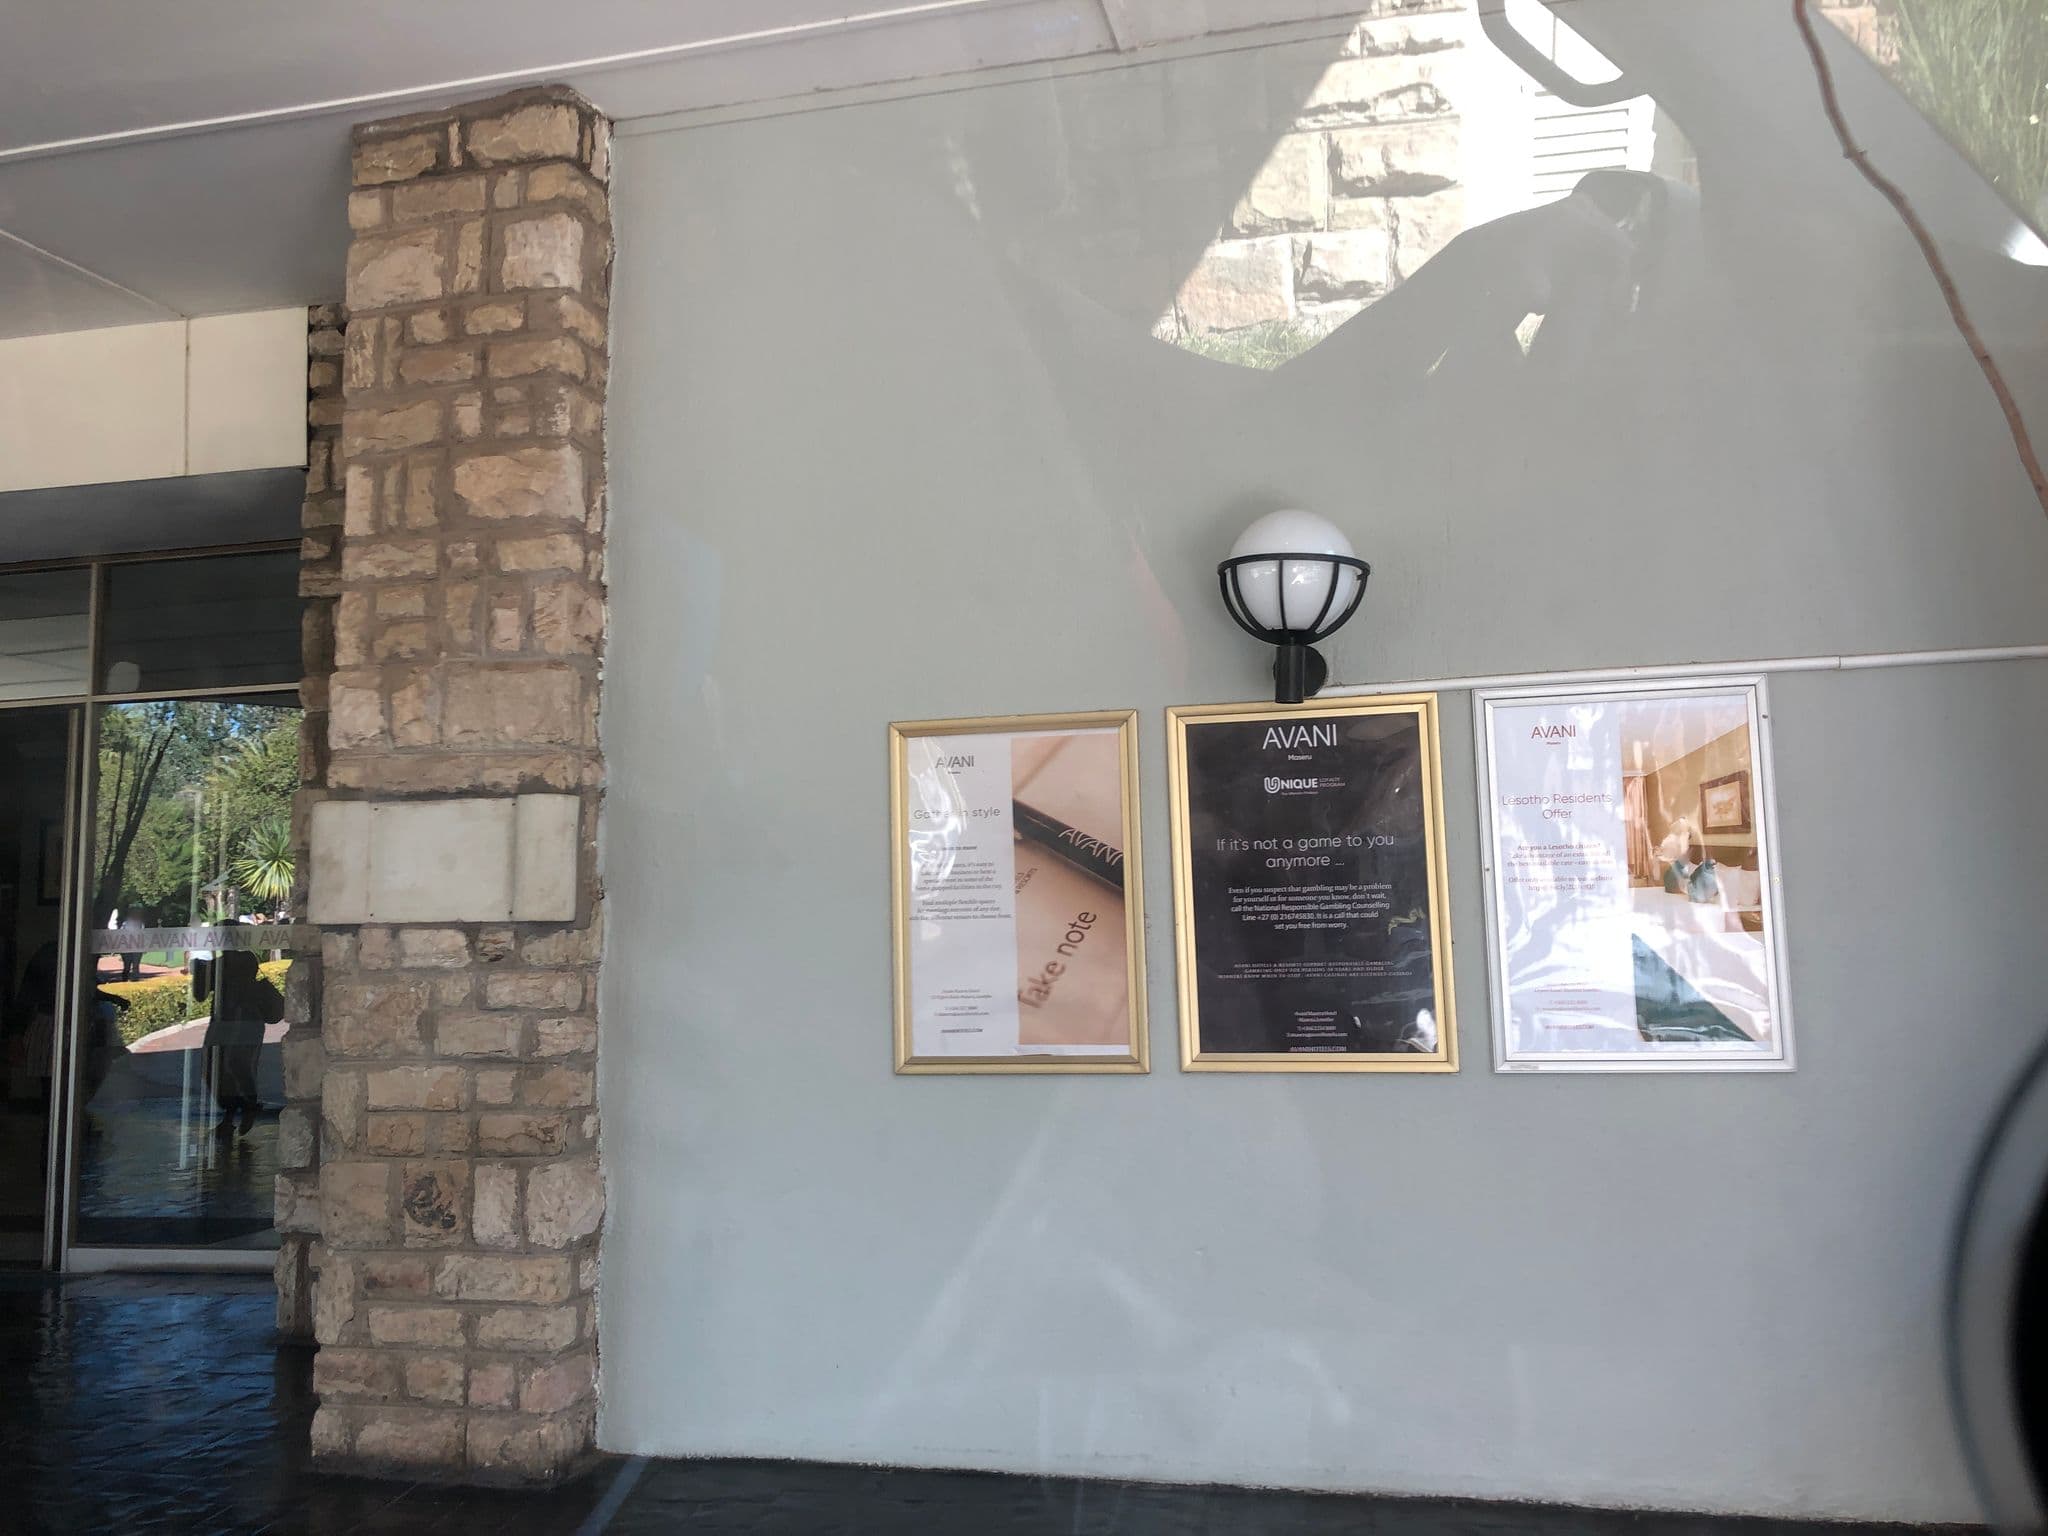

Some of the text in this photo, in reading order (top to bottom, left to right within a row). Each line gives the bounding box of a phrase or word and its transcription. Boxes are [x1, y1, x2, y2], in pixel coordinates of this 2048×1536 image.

[1262, 724, 1337, 750] AVANI
[1530, 724, 1576, 739] AVANI
[935, 755, 975, 768] AVANI
[1502, 792, 1613, 806] Lesotho Residents
[972, 806, 1001, 818] style
[1542, 808, 1572, 820] Offer
[1058, 828, 1122, 866] AVANI
[1216, 834, 1394, 851] If it's not a game to you
[1266, 856, 1330, 870] anymore
[1302, 884, 1334, 893] gambling
[1364, 883, 1392, 891] problem
[1243, 895, 1270, 904] yourself
[1282, 904, 1319, 912] Responsible
[1352, 902, 1390, 910] Counselling
[1360, 910, 1379, 918] could
[101, 933, 144, 950] AVANI
[150, 932, 197, 948] AVANI
[203, 931, 250, 948] AVANI
[1056, 912, 1096, 956] note
